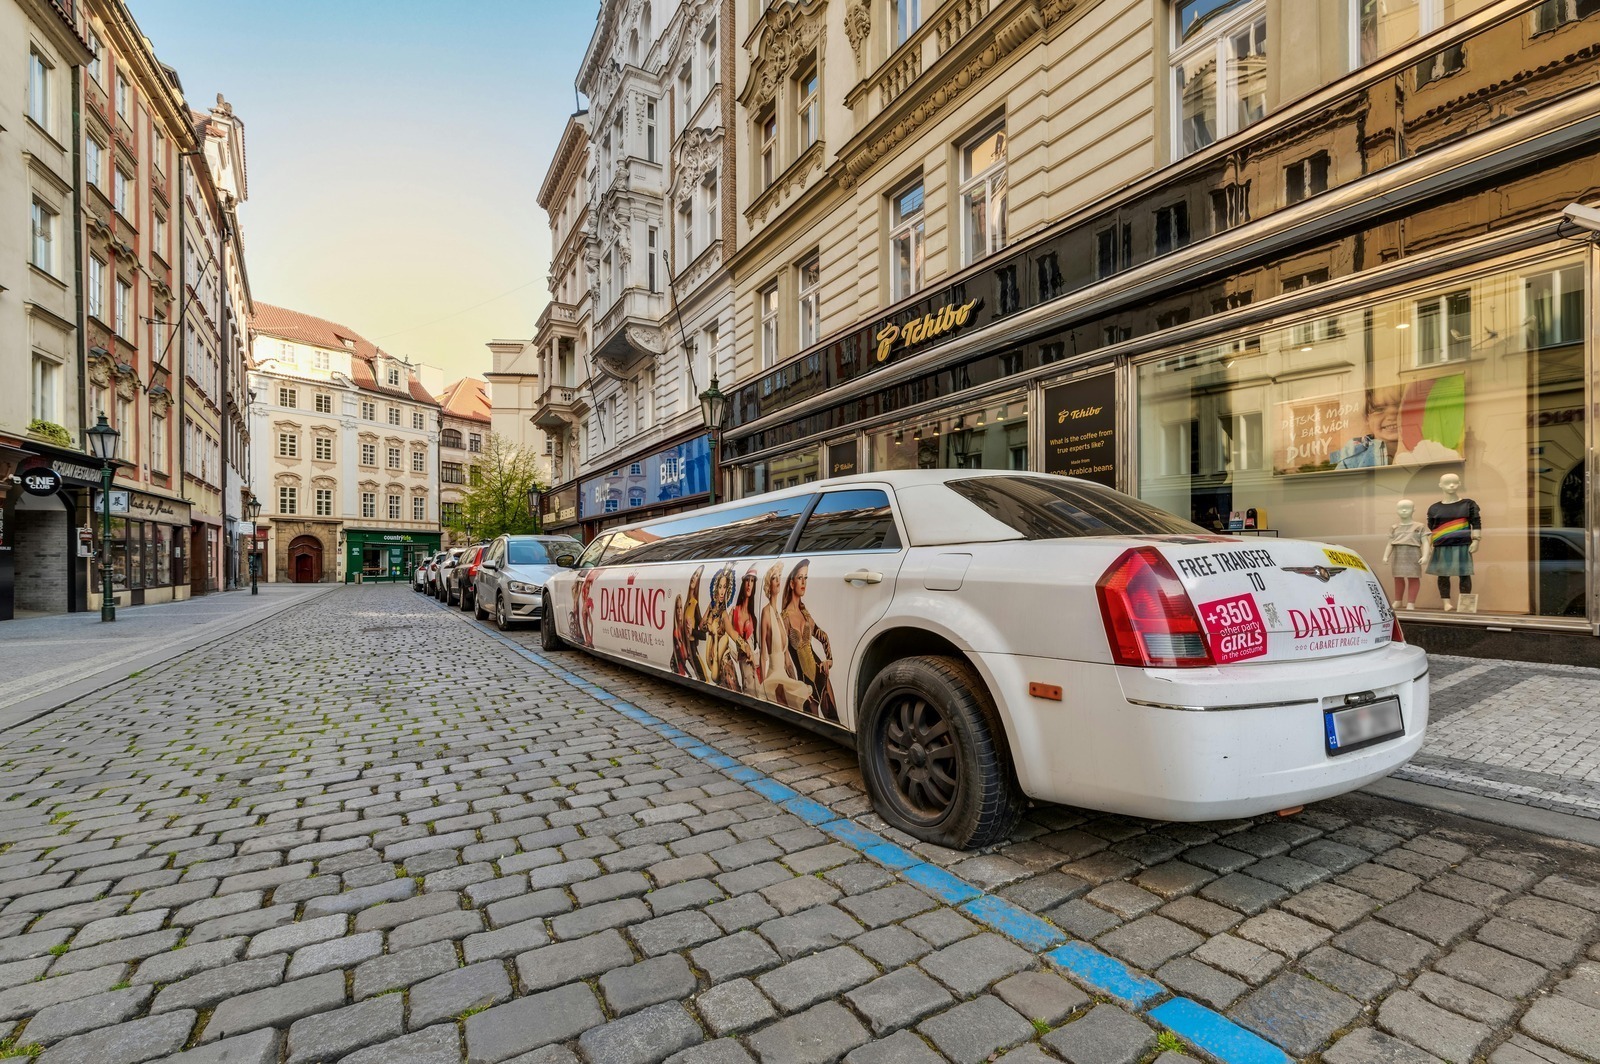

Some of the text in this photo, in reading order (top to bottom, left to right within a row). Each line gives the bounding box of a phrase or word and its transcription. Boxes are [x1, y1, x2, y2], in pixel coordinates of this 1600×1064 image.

[901, 297, 978, 347] Tchibo
[1070, 406, 1103, 419] Tchibo
[1050, 438, 1063, 446] What
[1080, 432, 1097, 440] coffee
[1099, 429, 1113, 437] from
[1301, 419, 1349, 438] BARVÁCH
[1069, 443, 1090, 452] experts
[1091, 440, 1104, 448] like?
[1286, 436, 1333, 464] DUHY
[660, 456, 685, 485] BLUE
[1069, 466, 1092, 475] Arabica
[1093, 464, 1113, 472] beans
[25, 476, 55, 486] ONE
[1177, 549, 1276, 579] FREE TRANSFER
[1246, 572, 1266, 592] TO
[600, 587, 666, 631] DARLING
[1207, 600, 1253, 627] +350
[1220, 621, 1259, 637] other party
[1287, 605, 1372, 639] DARLING
[610, 626, 654, 646] CABARET PRAGUE
[1221, 629, 1263, 653] GIRLS
[1310, 637, 1360, 651] CABARET PRAGUE
[1240, 646, 1263, 655] costume
